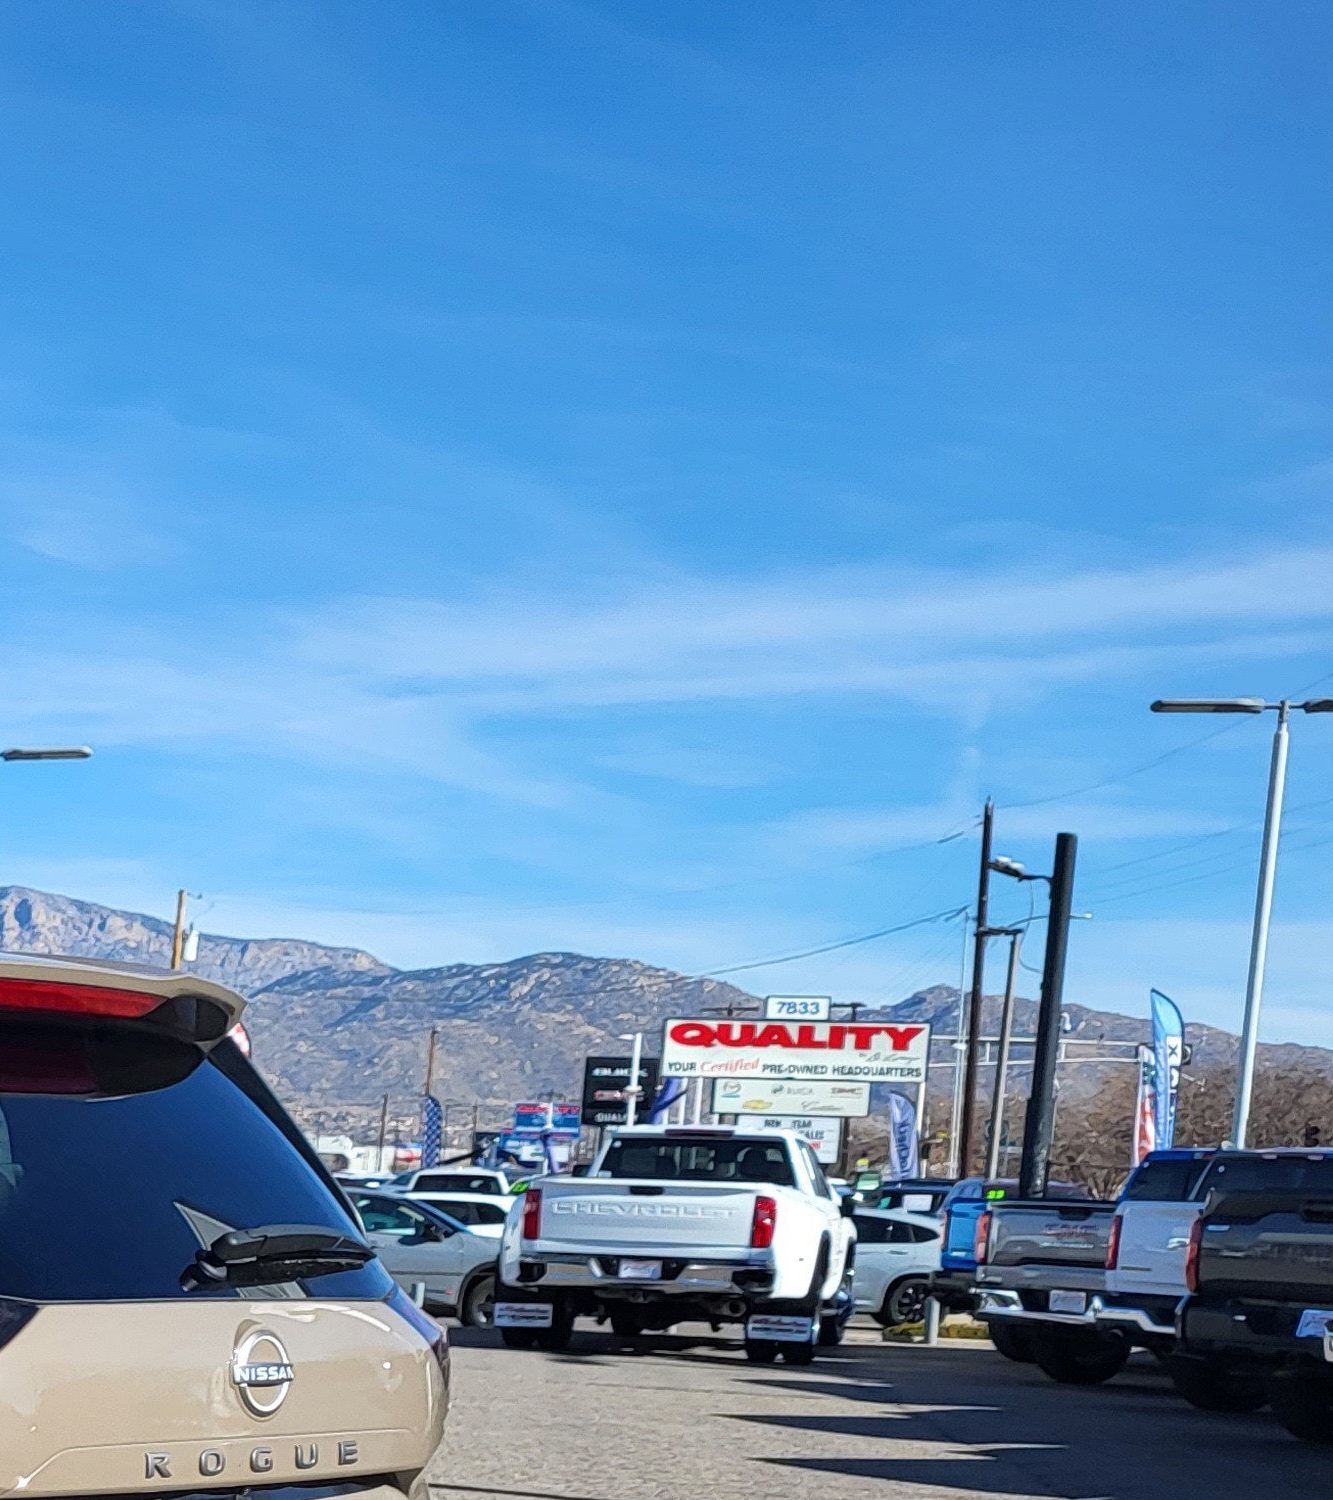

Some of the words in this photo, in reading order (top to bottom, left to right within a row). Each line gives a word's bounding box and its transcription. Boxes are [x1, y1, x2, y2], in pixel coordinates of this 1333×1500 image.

[776, 1001, 821, 1015] 7833
[670, 1022, 926, 1051] QUALITY
[667, 1061, 697, 1072] YOUR
[700, 1057, 761, 1073] Certified
[762, 1064, 828, 1076] PRE-OWNED
[833, 1066, 922, 1078] HEADQUARTERS
[551, 1201, 736, 1219] CHEVROLET
[236, 1364, 294, 1383] NISSAN
[144, 1439, 359, 1480] ROGUE
